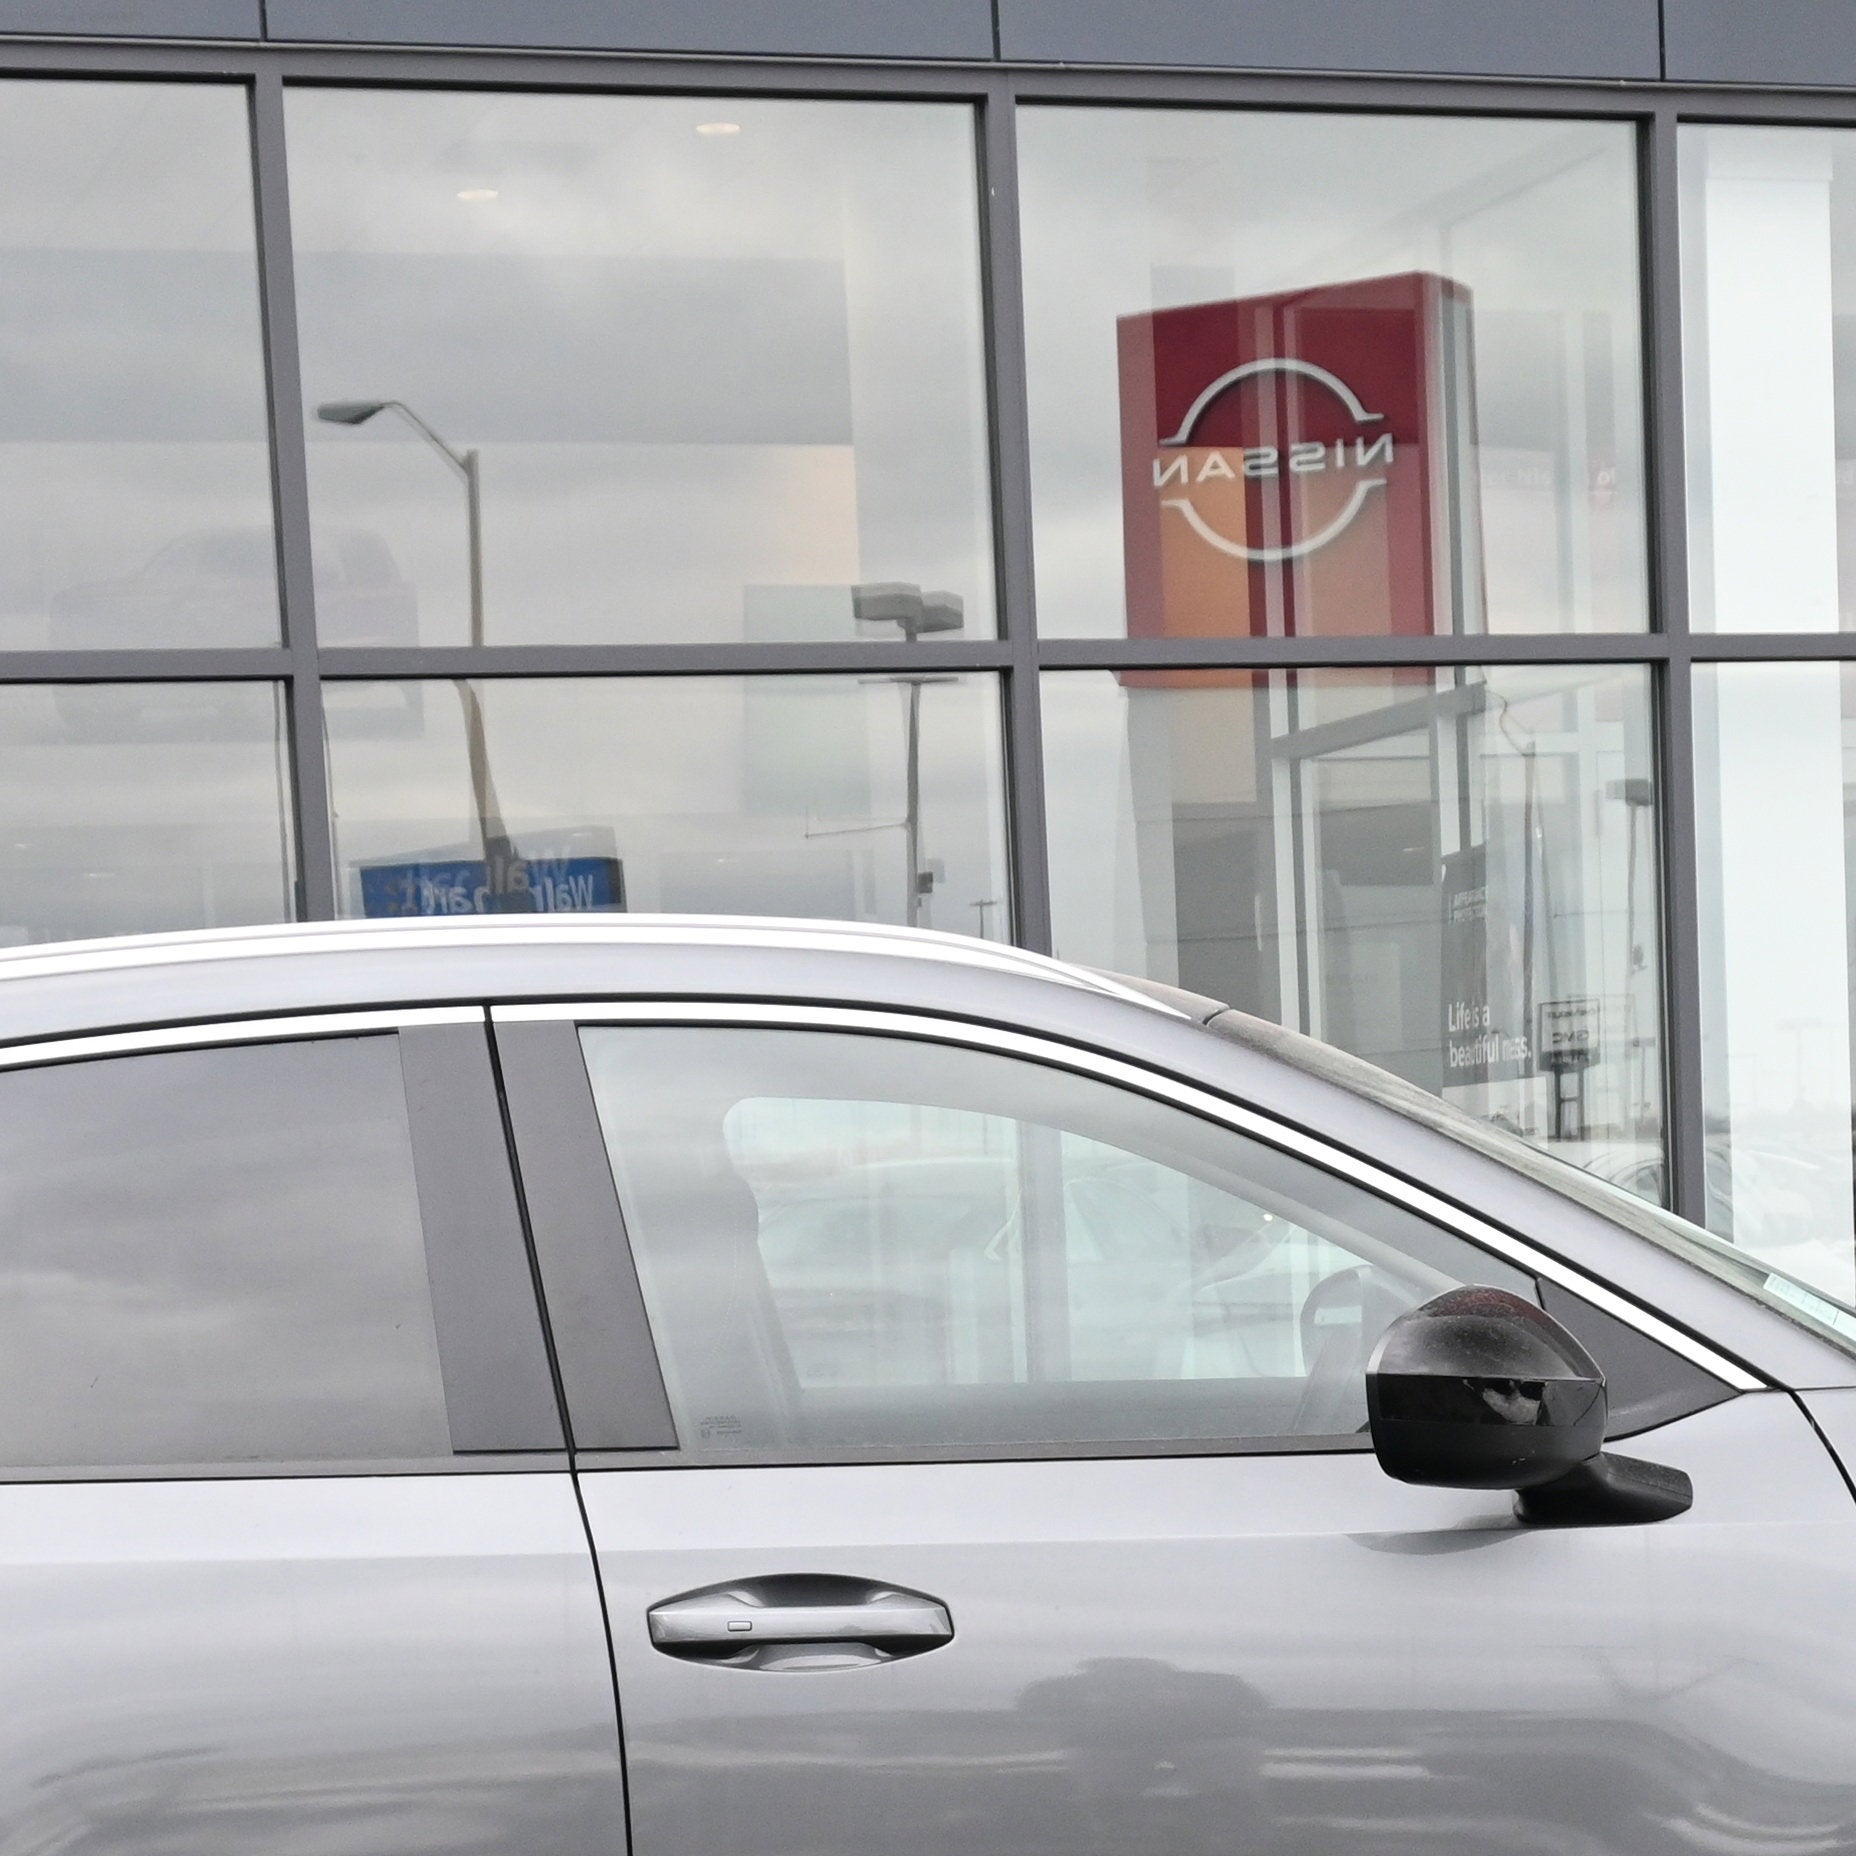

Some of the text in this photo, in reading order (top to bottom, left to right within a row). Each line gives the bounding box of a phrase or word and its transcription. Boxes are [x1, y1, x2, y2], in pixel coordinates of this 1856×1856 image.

[1447, 1001, 1470, 1033] Life
[1481, 1005, 1491, 1027] a
[1448, 1033, 1500, 1068] beautiful
[1501, 1035, 1532, 1061] mess.
